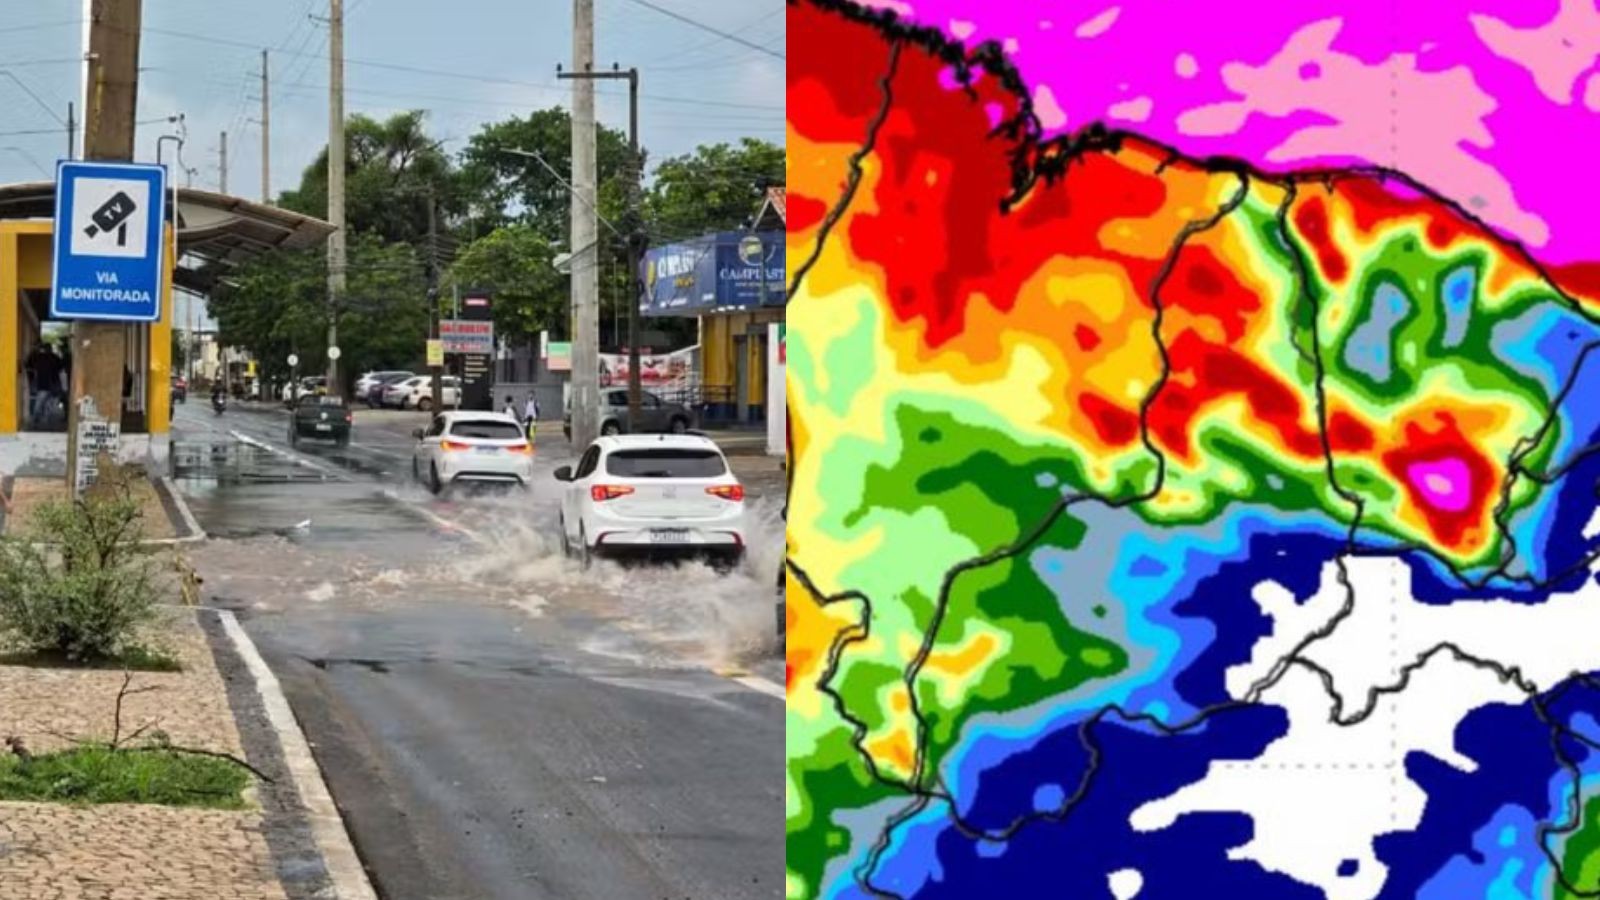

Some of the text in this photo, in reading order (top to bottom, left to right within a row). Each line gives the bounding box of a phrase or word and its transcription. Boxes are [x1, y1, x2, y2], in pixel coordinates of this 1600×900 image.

[103, 202, 122, 220] TV
[95, 271, 118, 284] VIA
[61, 287, 151, 303] MONITORADA
